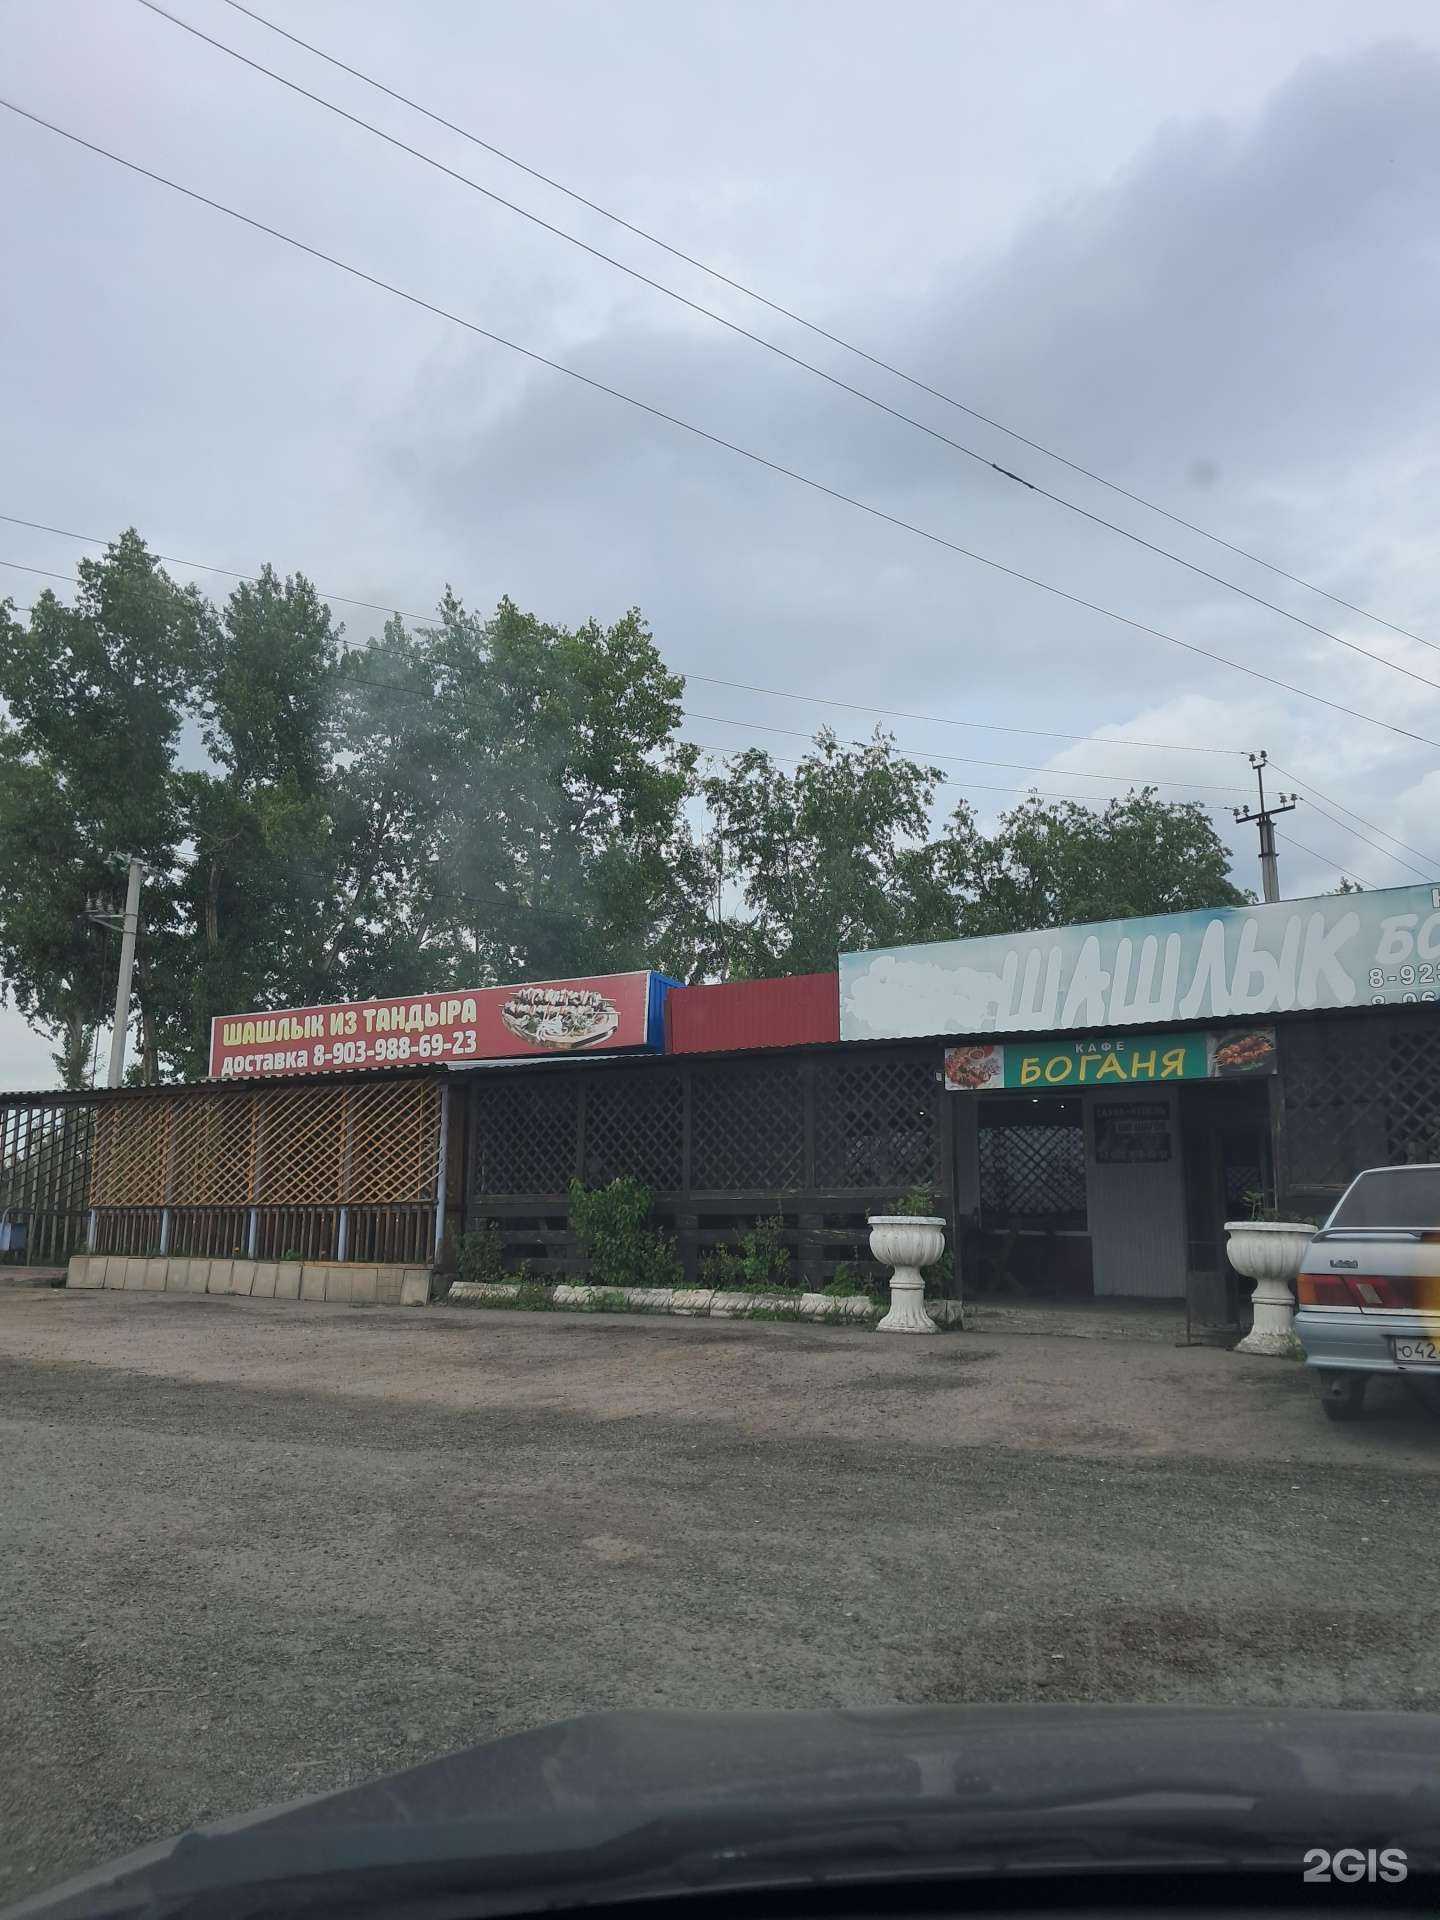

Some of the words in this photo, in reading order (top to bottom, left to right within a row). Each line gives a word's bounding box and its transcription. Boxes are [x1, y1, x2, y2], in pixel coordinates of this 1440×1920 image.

[995, 911, 1361, 1028] ШАШЛЫК
[1368, 962, 1440, 988] 8-92
[222, 1014, 325, 1046] ШАШЛЫК
[330, 1011, 358, 1036] ИЗ
[362, 998, 477, 1034] ТАНДЫРА
[221, 1050, 308, 1078] доставка
[313, 1029, 477, 1067] 8-903-988-69-23
[1020, 1047, 1187, 1085] БОГАНЯ
[1075, 1041, 1125, 1054] КАФЕ
